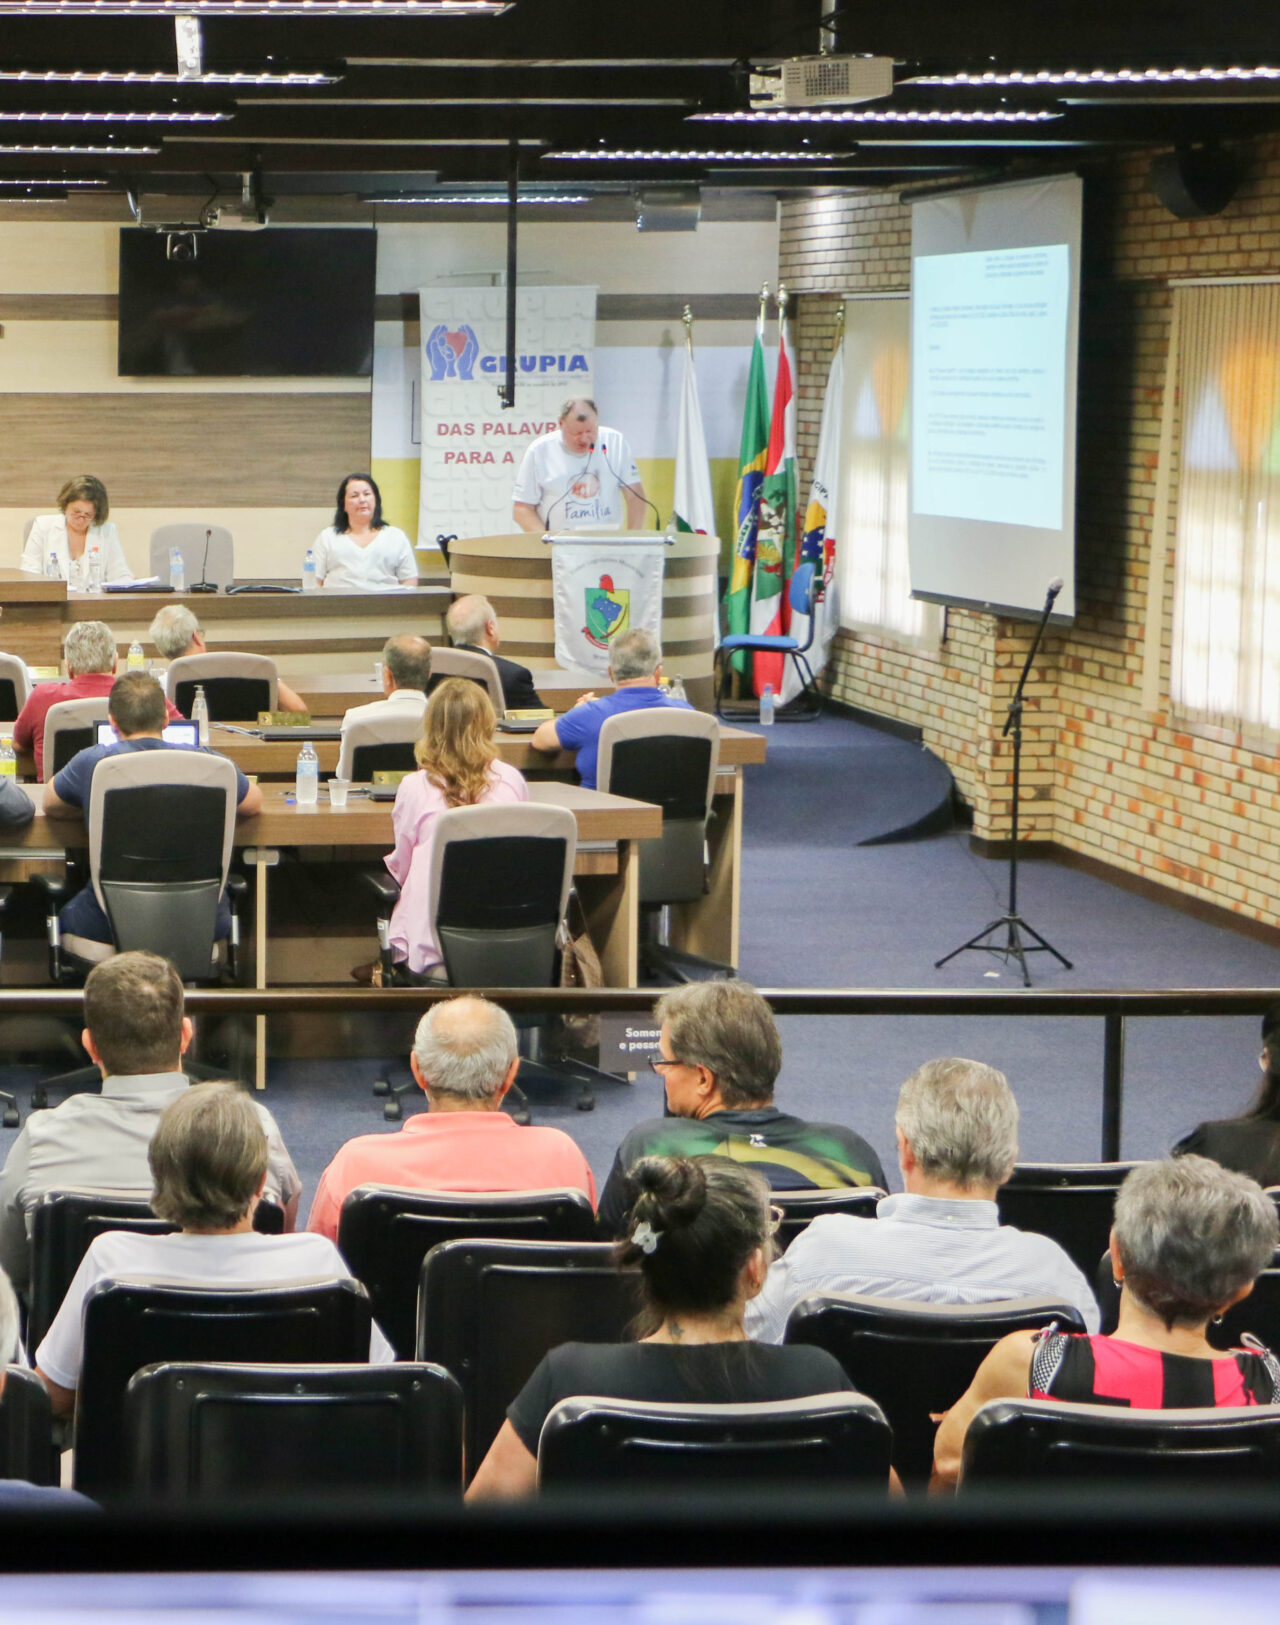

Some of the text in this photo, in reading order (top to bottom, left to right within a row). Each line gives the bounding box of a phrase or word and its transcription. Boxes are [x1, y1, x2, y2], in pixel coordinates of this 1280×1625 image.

[437, 423, 475, 436] DAS
[444, 451, 515, 465] PARA A
